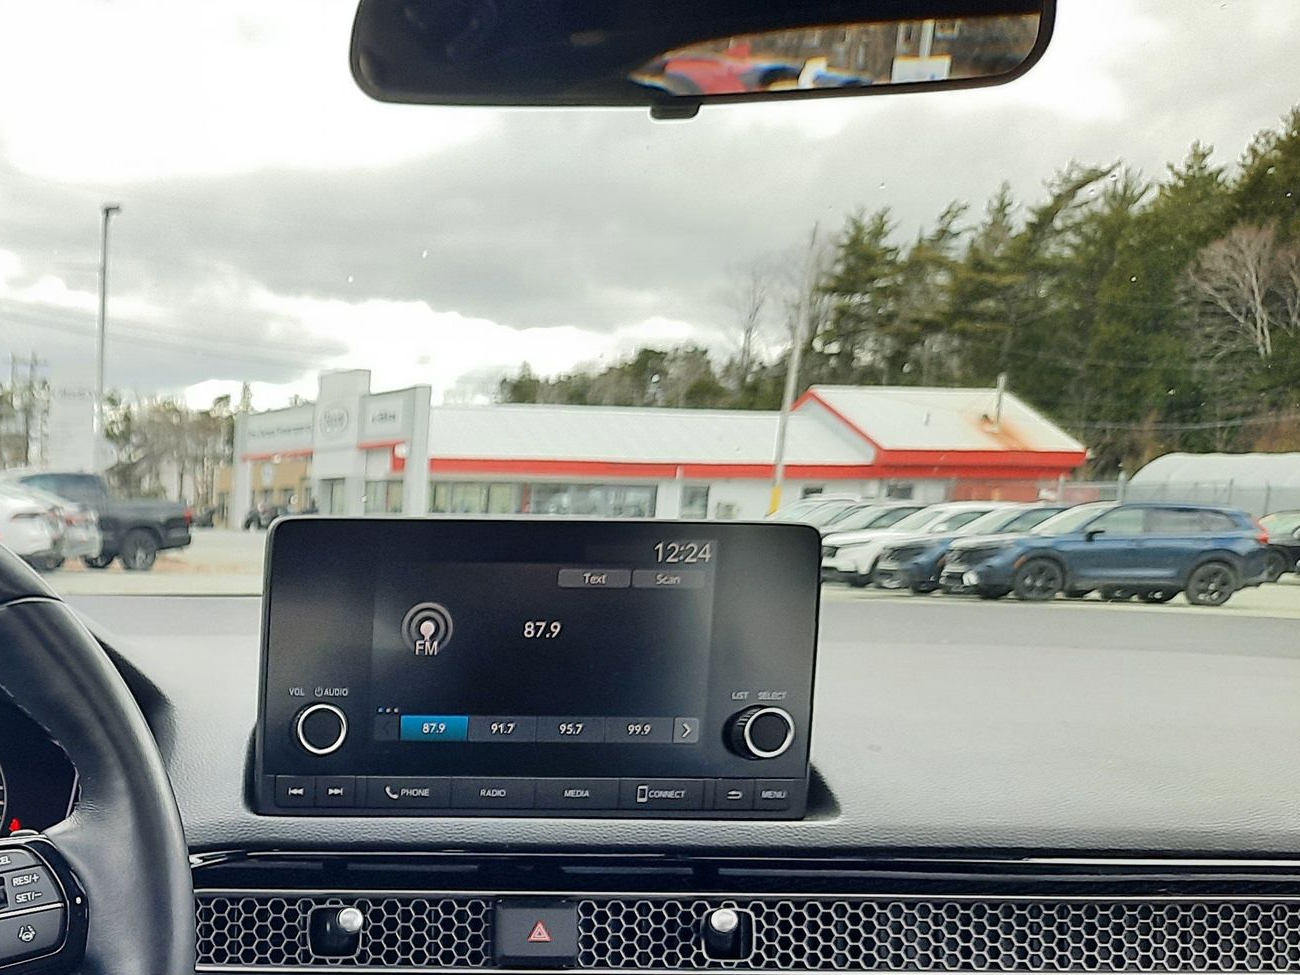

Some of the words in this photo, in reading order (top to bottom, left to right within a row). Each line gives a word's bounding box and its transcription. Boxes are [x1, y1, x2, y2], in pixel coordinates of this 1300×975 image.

[654, 542, 711, 563] 12:24
[583, 573, 607, 585] Text
[656, 574, 681, 585] Scan
[523, 621, 561, 638] 87.9
[415, 641, 438, 656] FM
[288, 688, 304, 697] VOL
[324, 688, 348, 697] AUDIO
[422, 723, 446, 735] 87.9
[491, 723, 515, 735] 91.7
[559, 723, 584, 735] 95.7
[628, 724, 652, 736] 99.9
[400, 788, 430, 798] PHONE
[480, 789, 506, 798] RADIO
[564, 789, 590, 799] MEDIA
[649, 789, 686, 799] CONNECT
[762, 790, 787, 799] MENU
[12, 874, 40, 887] RES/+
